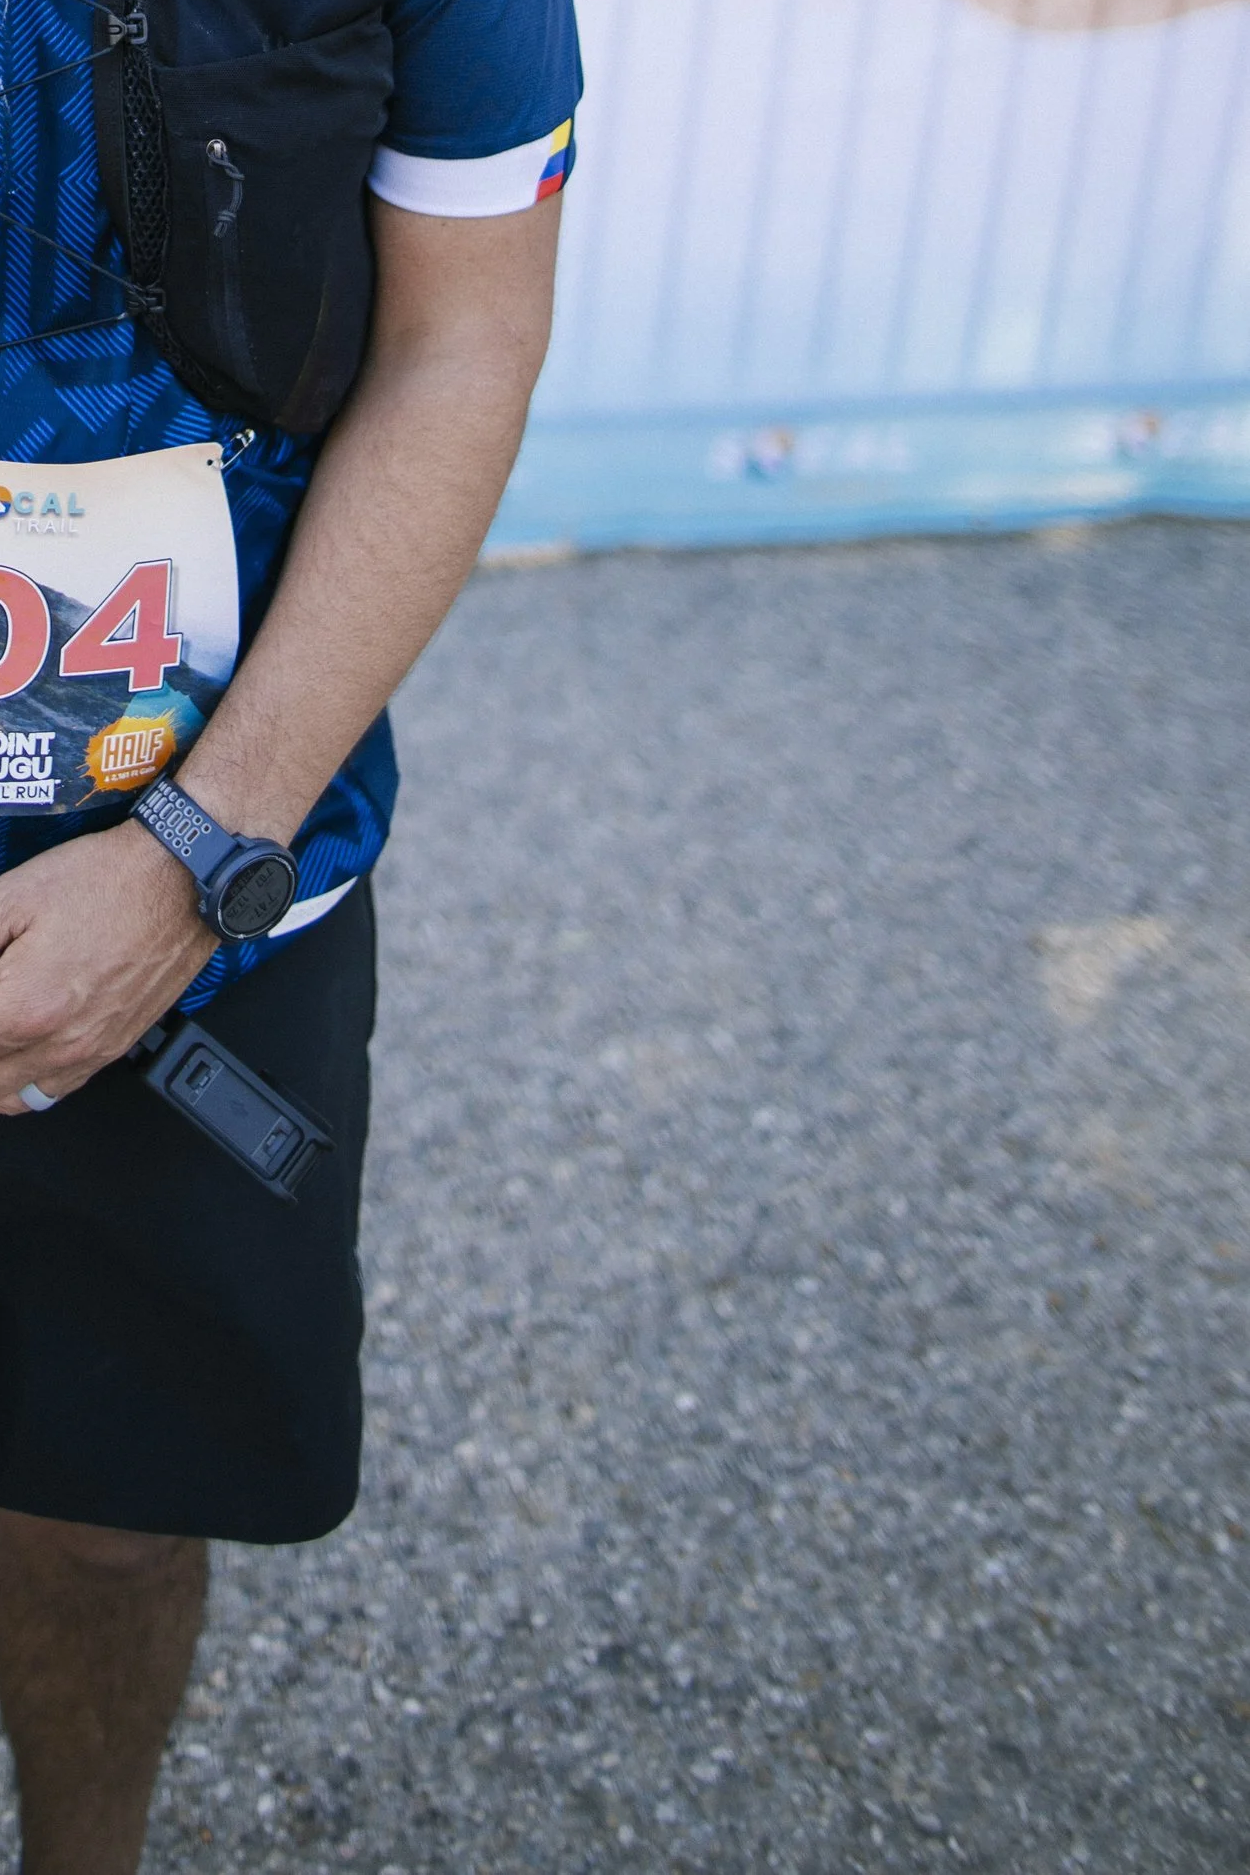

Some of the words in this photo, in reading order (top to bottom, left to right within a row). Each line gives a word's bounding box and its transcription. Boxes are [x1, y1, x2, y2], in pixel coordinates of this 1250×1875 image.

[13, 517, 79, 534] TRAIL
[102, 728, 164, 772] HALF
[16, 785, 49, 799] RUN
